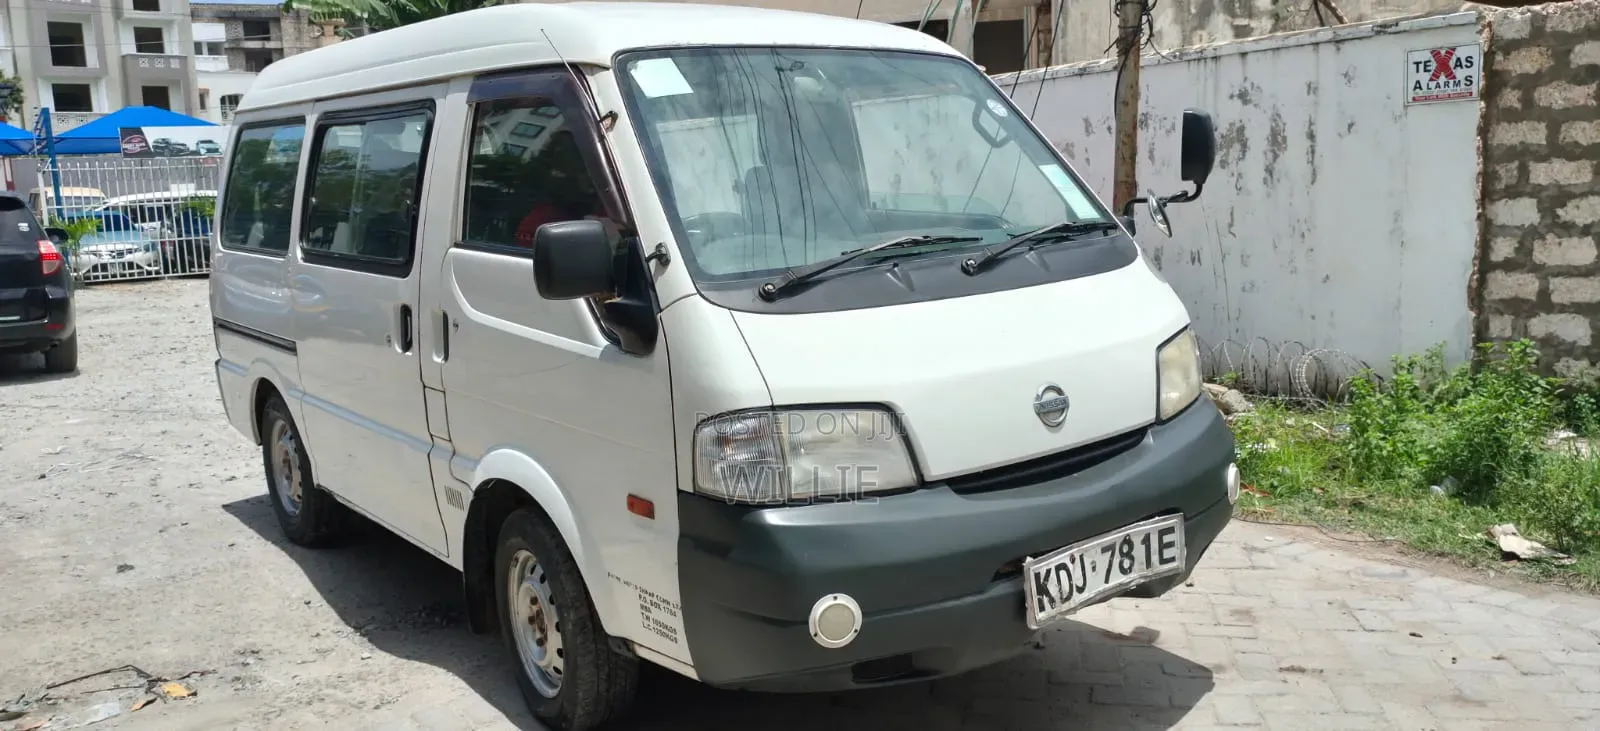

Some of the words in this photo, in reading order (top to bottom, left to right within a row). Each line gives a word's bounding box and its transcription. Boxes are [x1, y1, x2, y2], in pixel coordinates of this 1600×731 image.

[1413, 48, 1474, 81] TEXAS
[1413, 75, 1474, 91] ALARMS
[1033, 553, 1087, 613] KDJ
[1101, 526, 1176, 585] 781E
